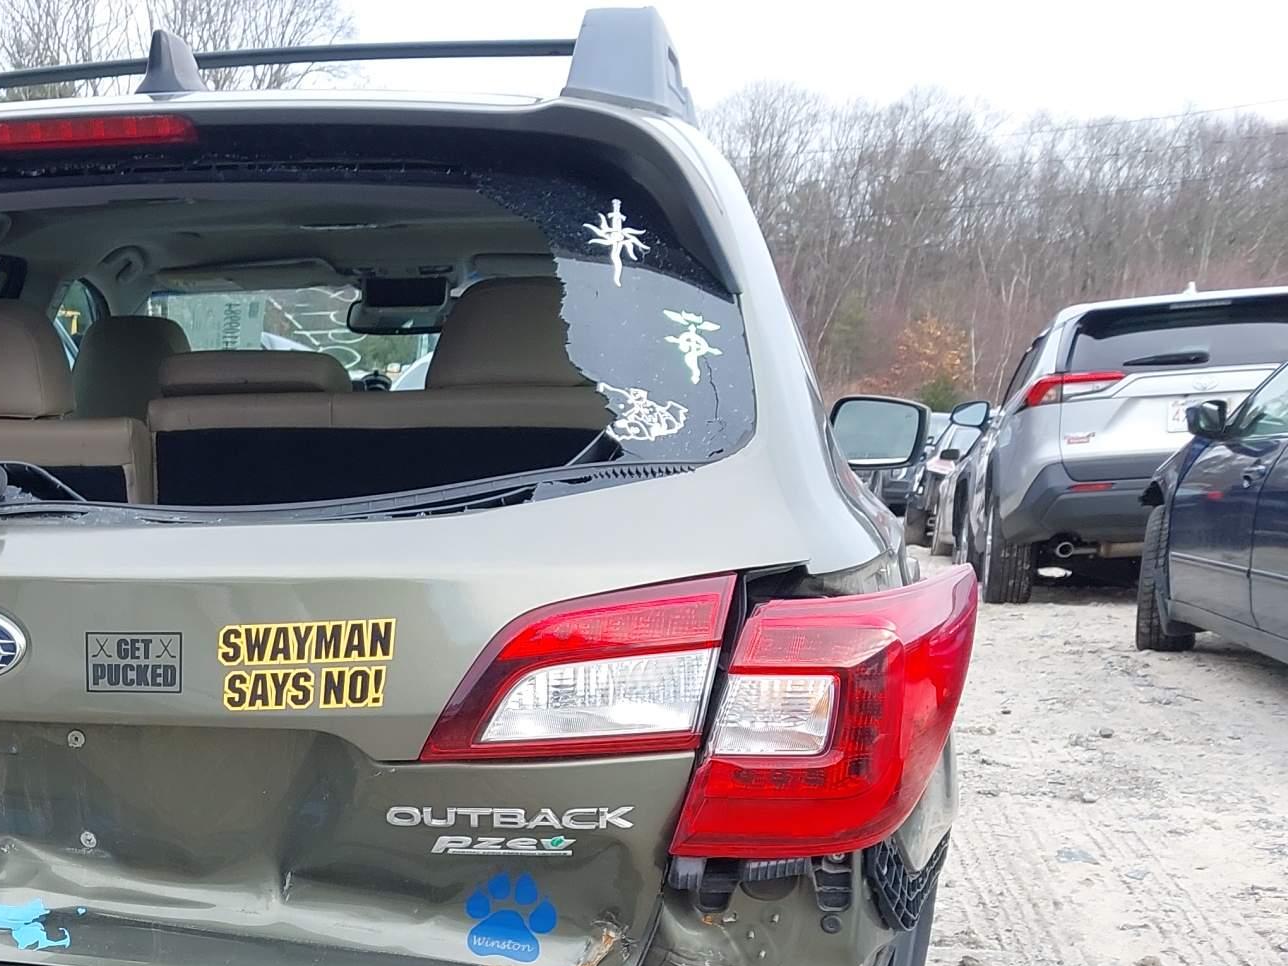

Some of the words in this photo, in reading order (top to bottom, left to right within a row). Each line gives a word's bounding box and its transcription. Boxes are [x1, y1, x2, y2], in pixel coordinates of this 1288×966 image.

[116, 638, 153, 660] GET
[220, 620, 394, 665] SWAYMAN
[92, 663, 177, 687] PUCKED
[225, 671, 314, 710] SAYS
[321, 668, 385, 707] NO!
[386, 805, 636, 831] OUTBACK
[472, 934, 535, 954] Winston
